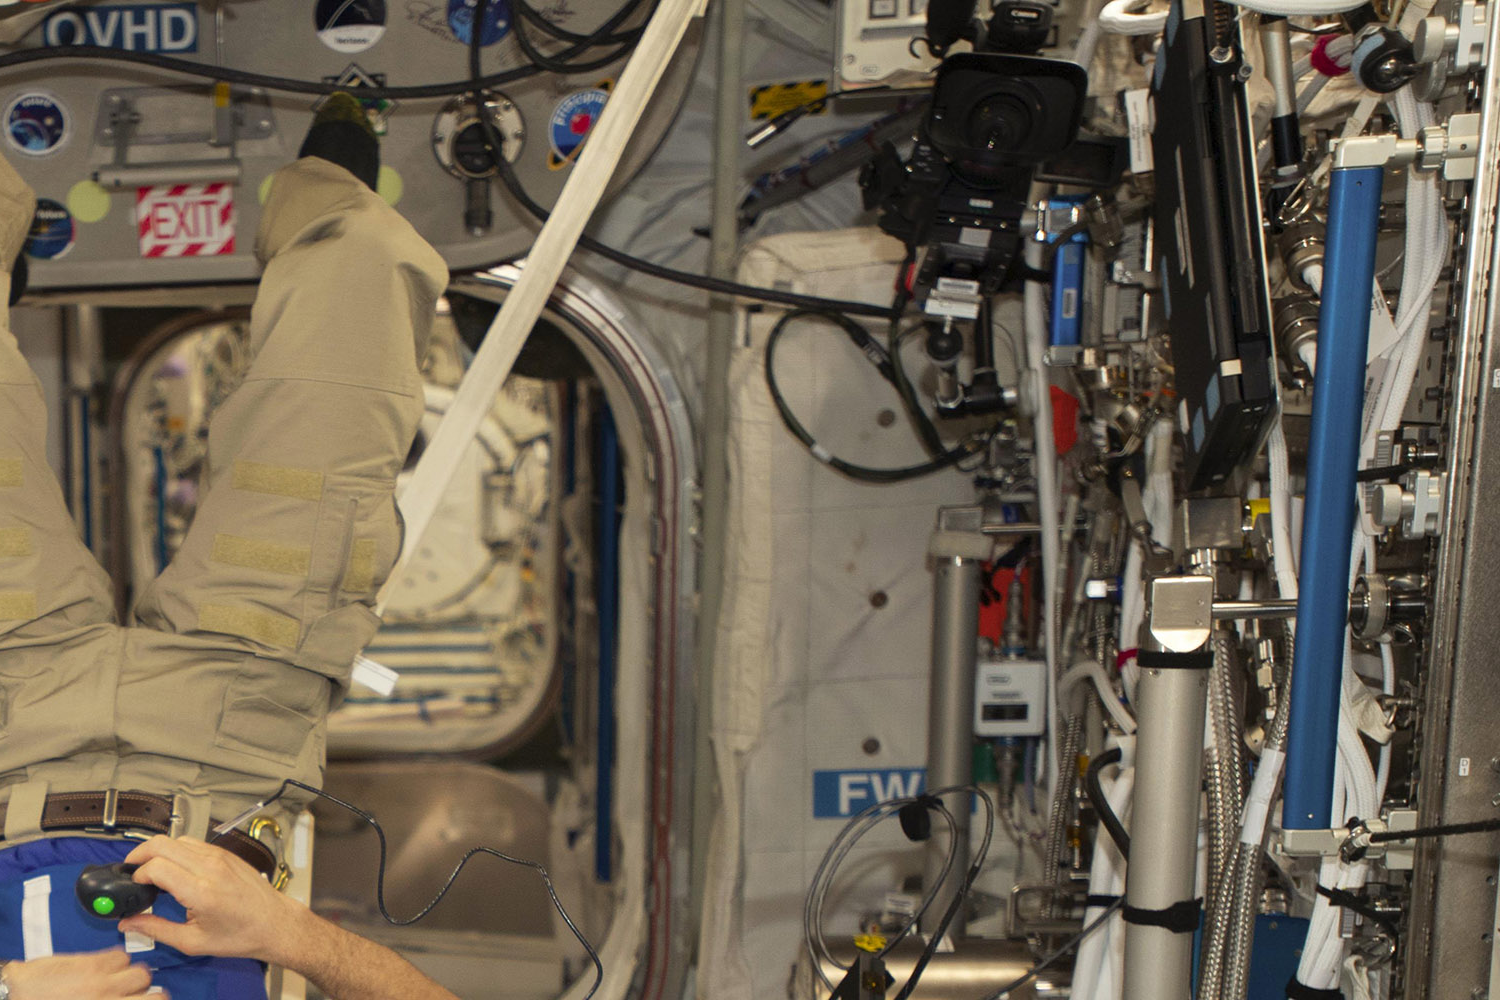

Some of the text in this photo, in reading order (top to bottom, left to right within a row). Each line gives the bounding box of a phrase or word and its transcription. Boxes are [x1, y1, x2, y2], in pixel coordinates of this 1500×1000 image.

[46, 8, 196, 50] OVHD
[152, 200, 214, 239] EXIT
[837, 771, 924, 814] FW
